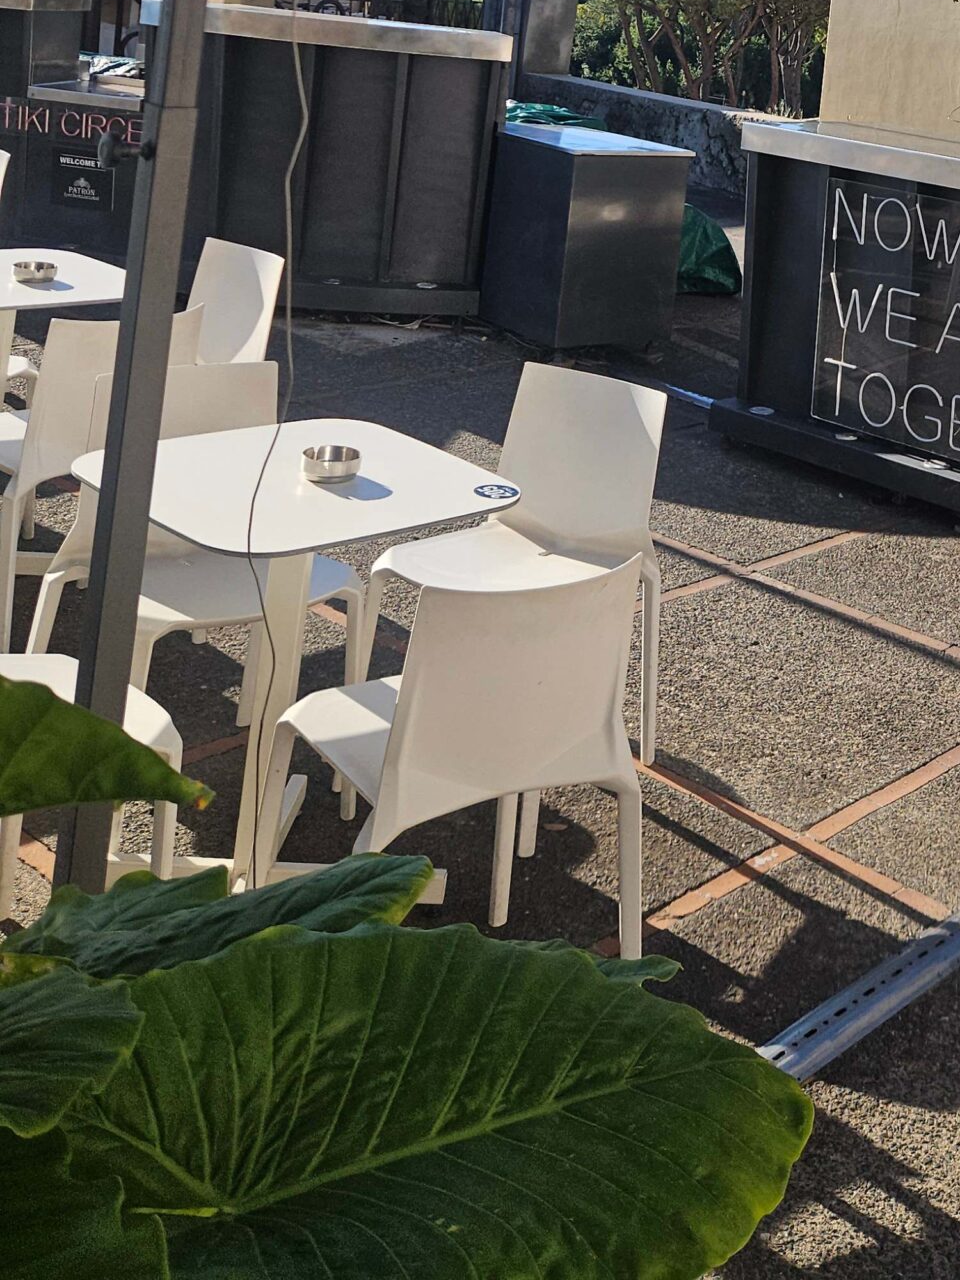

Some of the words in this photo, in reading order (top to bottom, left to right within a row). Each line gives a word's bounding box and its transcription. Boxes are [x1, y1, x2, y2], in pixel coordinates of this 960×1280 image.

[0, 102, 49, 133] TIKI
[61, 111, 144, 145] CIRCE
[60, 156, 96, 168] WELCOME
[829, 271, 921, 348] WE
